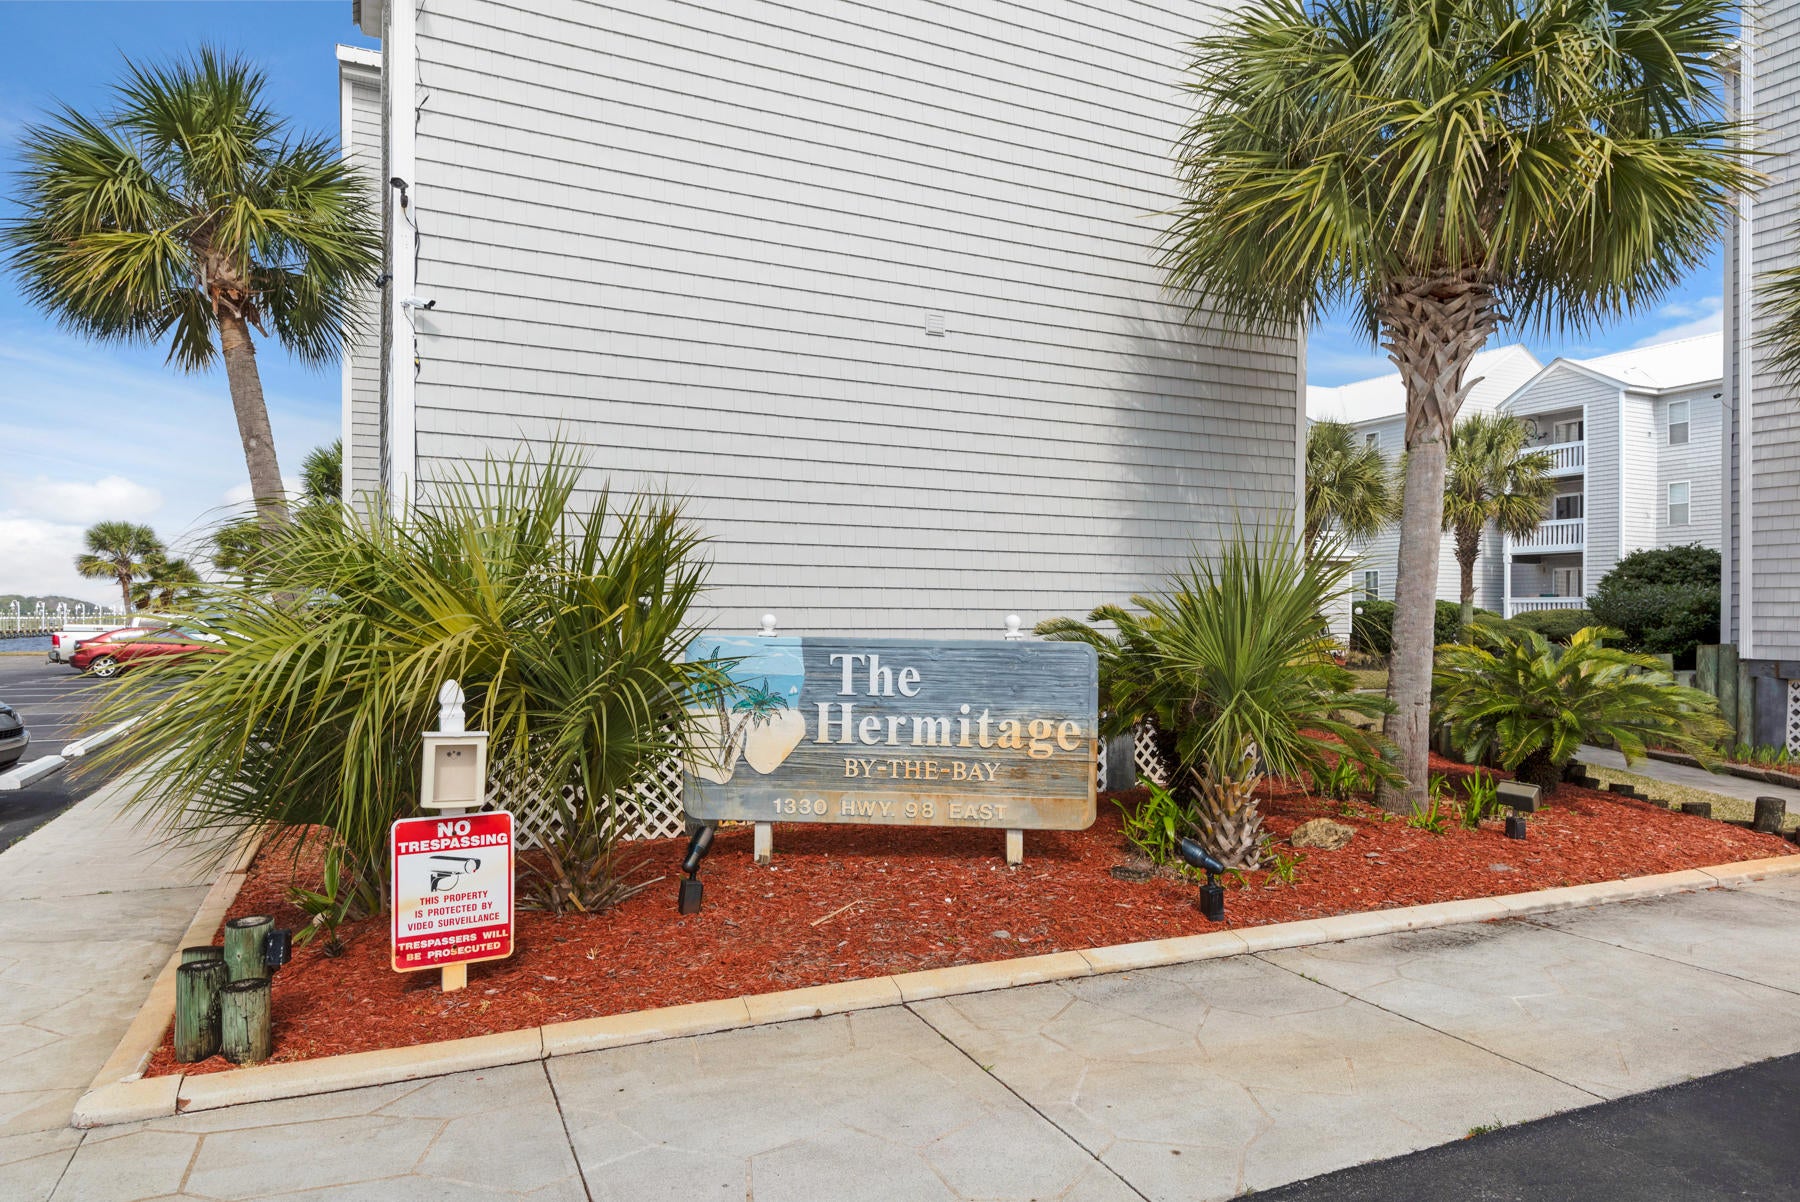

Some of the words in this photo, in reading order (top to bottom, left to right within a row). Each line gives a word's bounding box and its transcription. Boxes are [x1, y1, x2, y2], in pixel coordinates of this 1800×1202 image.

[830, 653, 921, 697] The
[813, 701, 1081, 759] Hermitage
[844, 758, 1001, 782] BY-THE-BAY
[773, 797, 828, 816] 1330
[905, 801, 935, 819] 98
[949, 802, 1008, 820] EAST
[437, 820, 471, 838] NO
[398, 833, 508, 853] TRESPASSING
[420, 896, 439, 906] THIS
[444, 890, 488, 903] PROPERTY
[415, 910, 423, 918] IS
[428, 904, 477, 917] PROTECTED
[482, 901, 493, 910] BY
[407, 920, 434, 931] VIDEO
[438, 912, 500, 927] SURVEILLANCE
[398, 933, 477, 951] TRESPASSERS
[483, 929, 509, 939] WILL
[406, 953, 422, 961] BE
[428, 941, 501, 959] PROSECUTED
